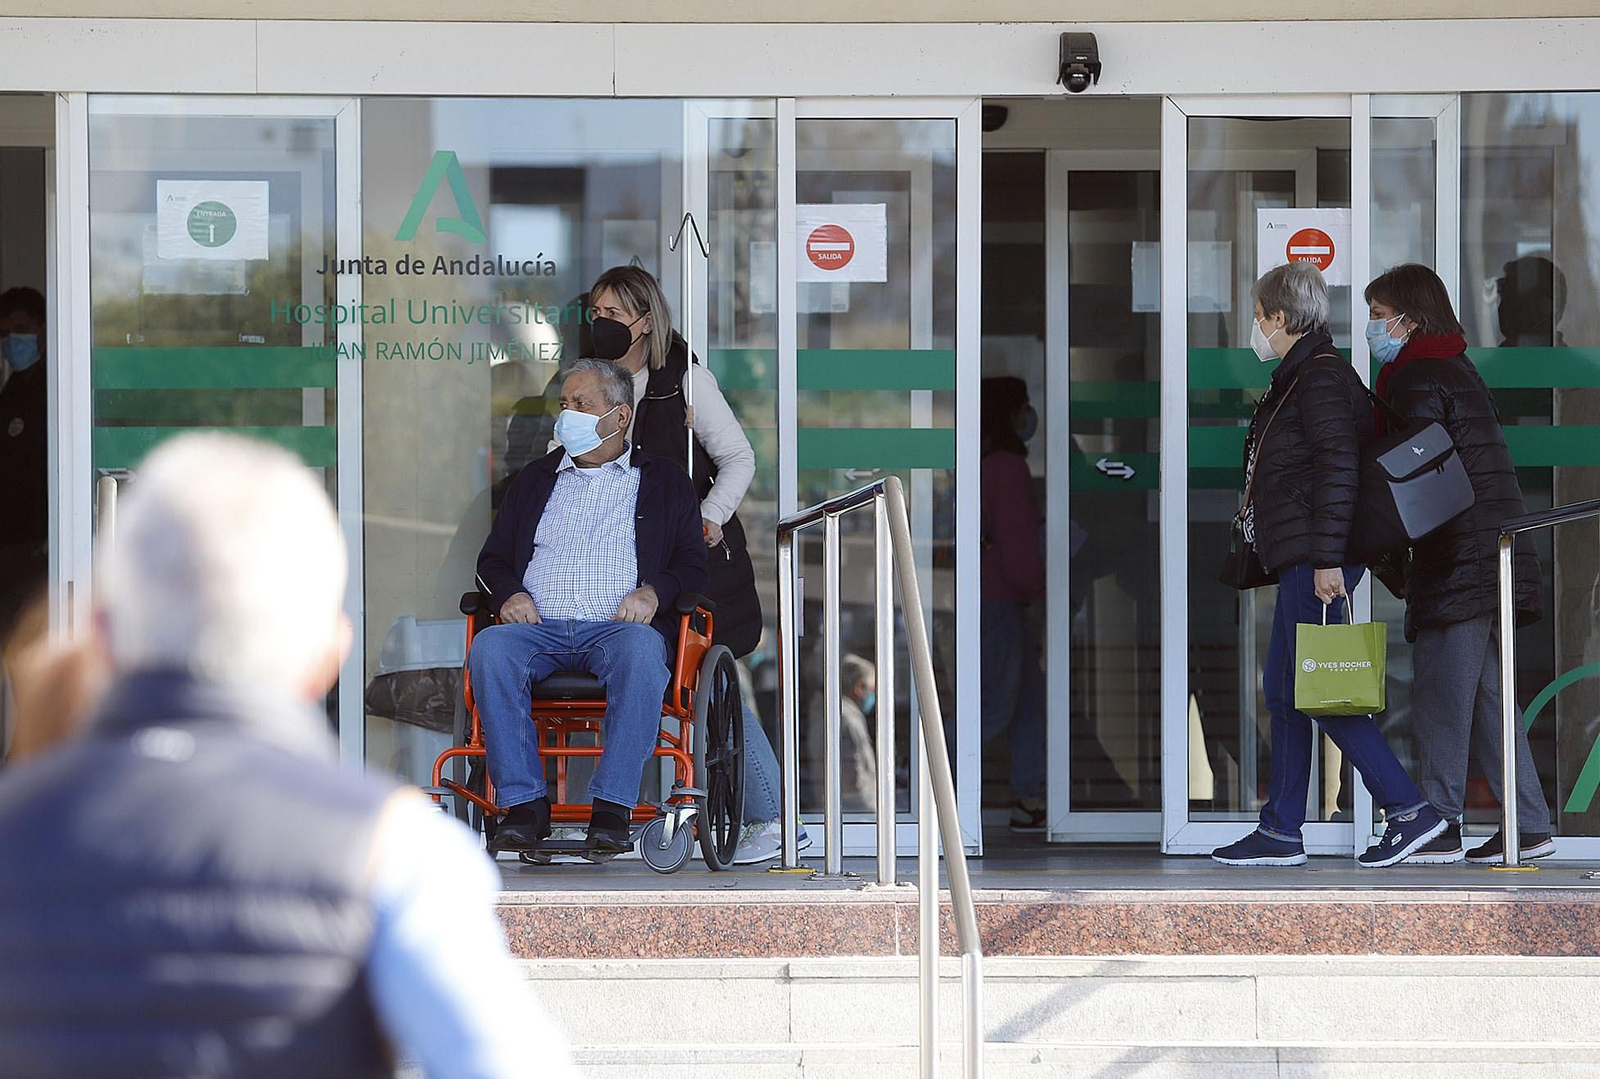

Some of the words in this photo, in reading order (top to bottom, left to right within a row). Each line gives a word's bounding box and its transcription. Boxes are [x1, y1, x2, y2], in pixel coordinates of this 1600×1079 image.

[316, 254, 387, 275] Junta
[395, 254, 426, 275] de
[432, 252, 557, 275] Andalucía
[270, 298, 395, 332] Hospital
[309, 341, 367, 364] JUAN
[376, 337, 462, 361] RAMÓN
[467, 337, 564, 365] JIMÉNEZ
